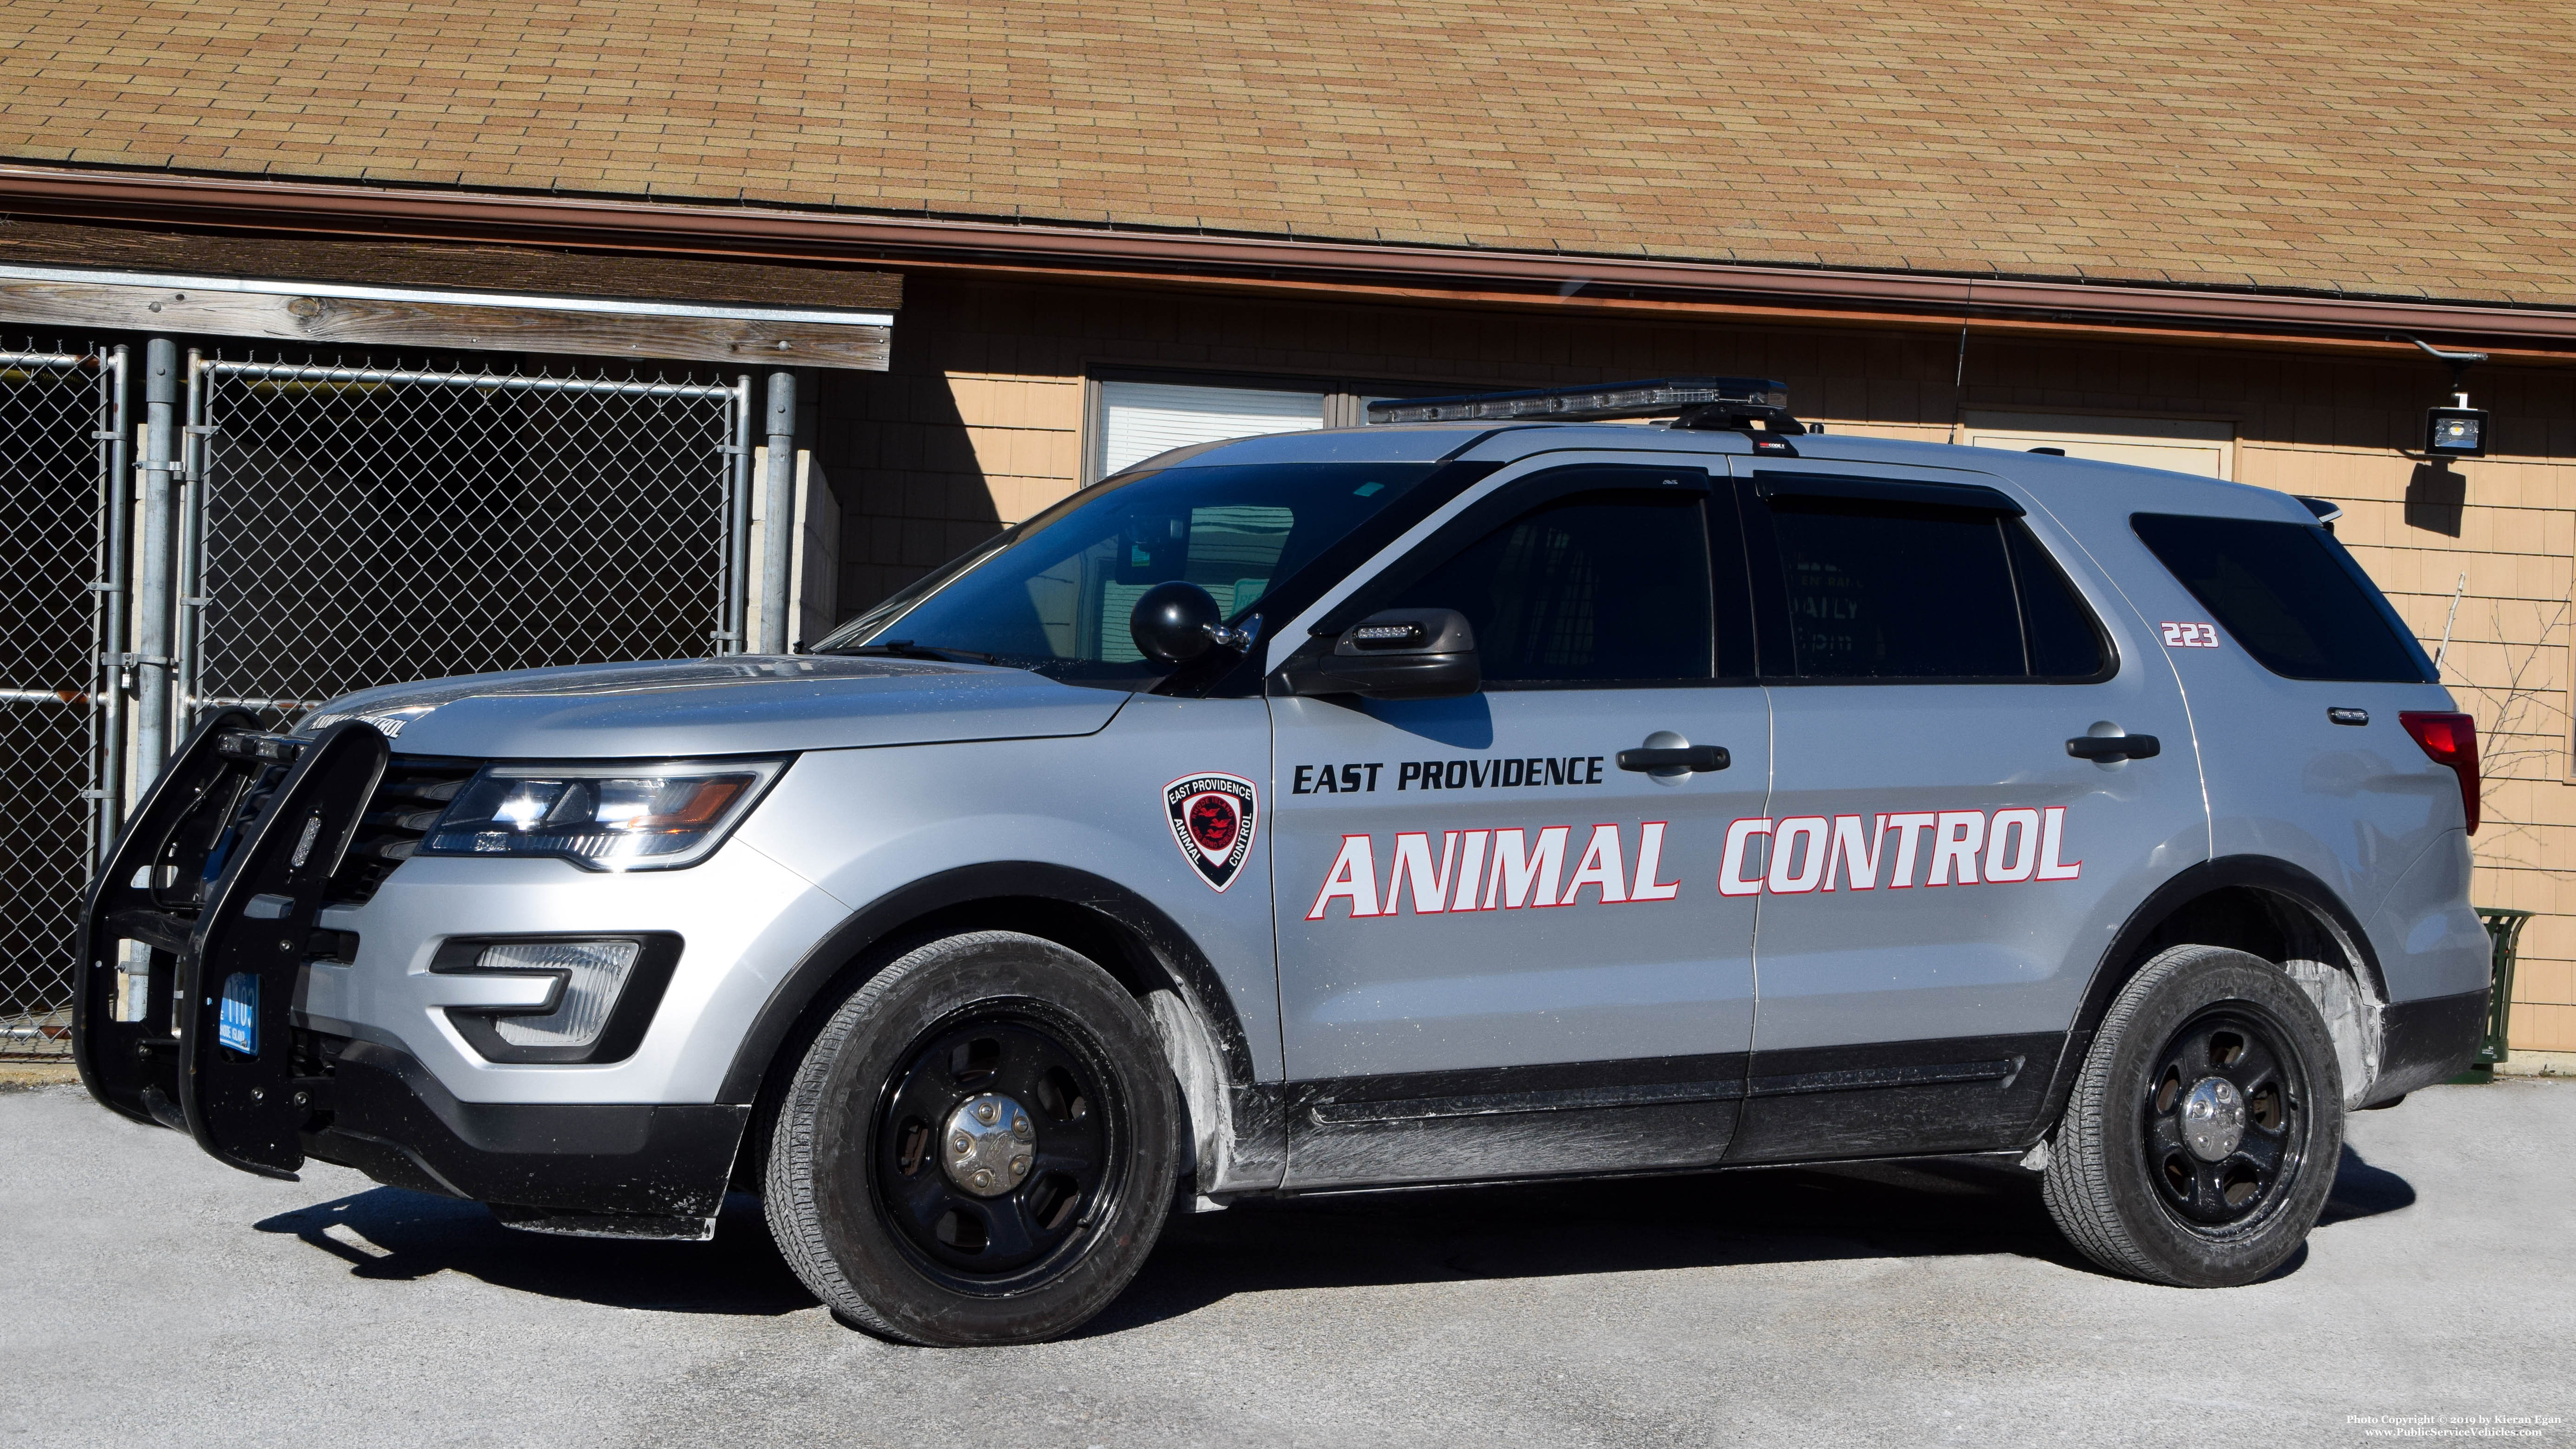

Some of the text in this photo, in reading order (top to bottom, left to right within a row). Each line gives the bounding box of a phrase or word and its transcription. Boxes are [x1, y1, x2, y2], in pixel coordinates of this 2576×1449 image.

[2161, 621, 2219, 648] 223
[1292, 756, 1604, 794] EAST PROVIDENCE
[1169, 779, 1252, 805] EAST PROVIDENCE
[1192, 798, 1233, 819] RHODE ISLAND
[1174, 813, 1252, 867] ANIMAL CONTROL
[1193, 826, 1203, 839] PRO
[1202, 838, 1217, 848] BONO
[1304, 806, 2083, 921] ANIMAL CONTROL
